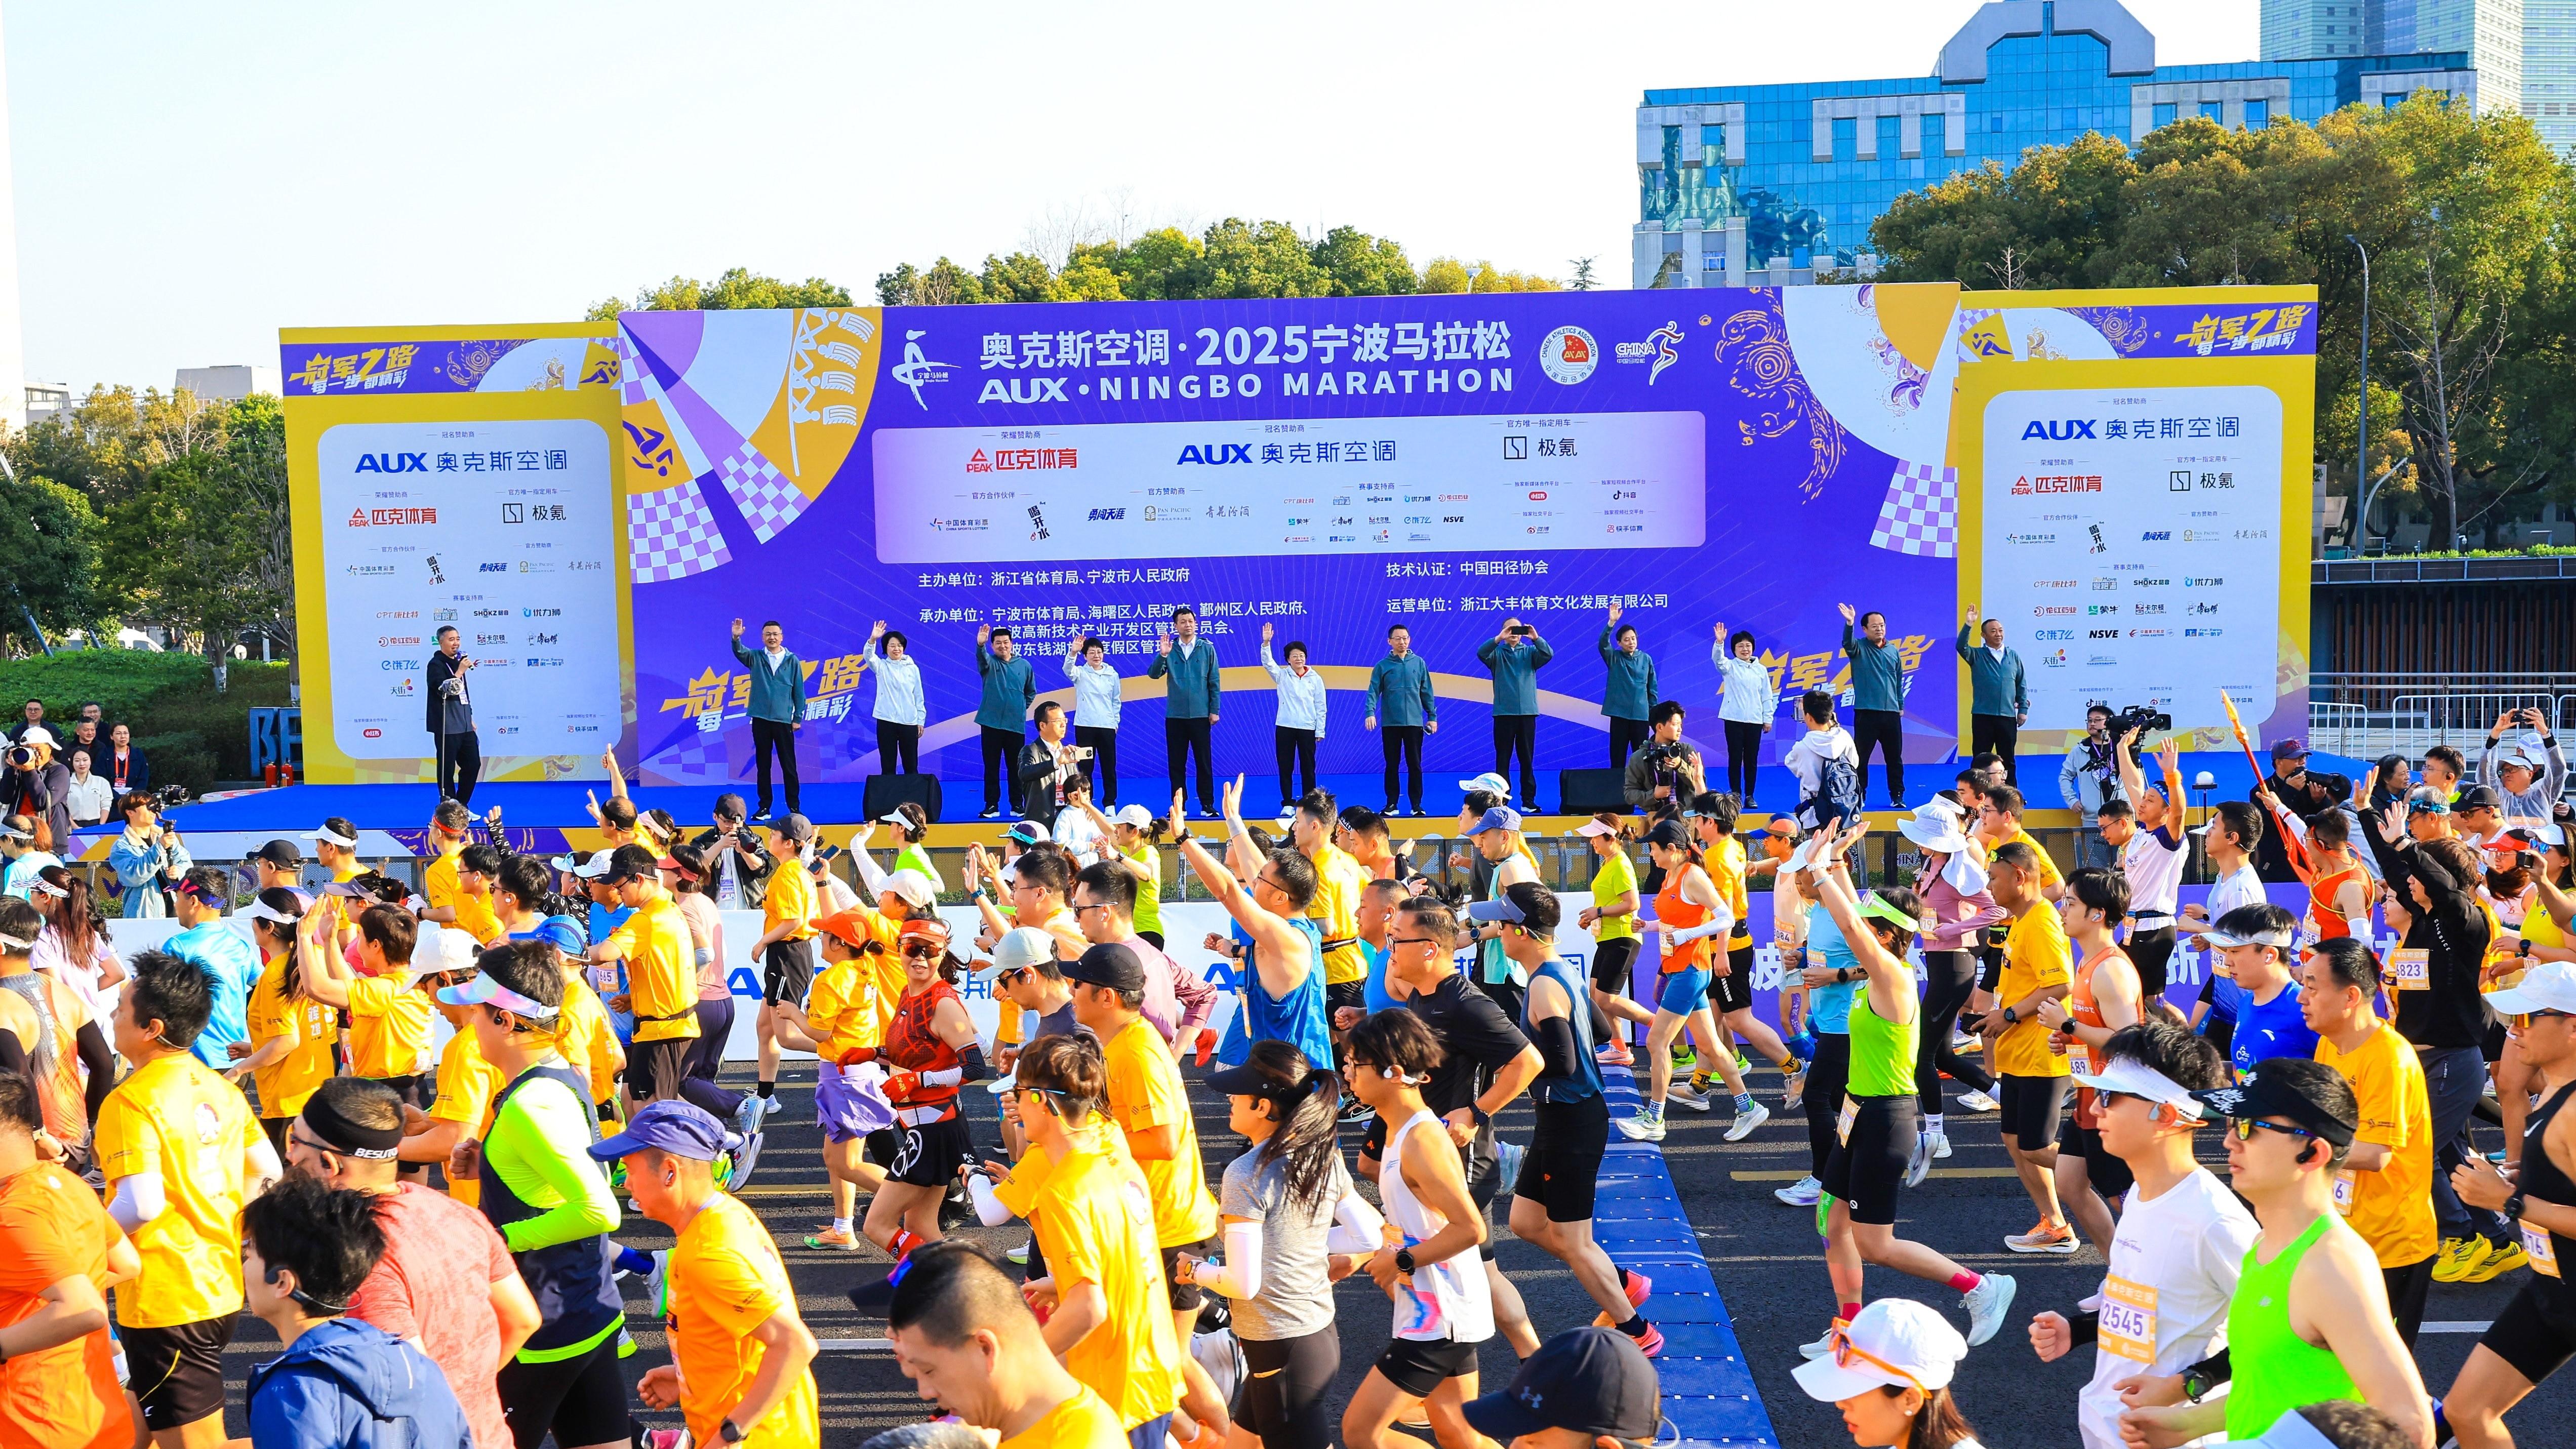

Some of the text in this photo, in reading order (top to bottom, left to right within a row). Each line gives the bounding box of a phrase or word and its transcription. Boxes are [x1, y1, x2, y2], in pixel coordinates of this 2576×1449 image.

[1542, 337, 1553, 358] CHINESE
[1552, 328, 1577, 340] ATHLETICS
[1577, 330, 1597, 357] ASSOCIATION
[1616, 343, 1656, 355] CHINA
[1284, 369, 1513, 396] MARATHON
[1264, 424, 1305, 434] 冠名赞助商
[1507, 419, 1571, 427] 官方唯一指定用车
[2022, 417, 2239, 440] AUX 奥克斯空调
[1001, 431, 1041, 439] 荣耀赞助商
[1177, 440, 1396, 465] AUX 奥克斯空调
[1539, 438, 1577, 457] 极氪
[355, 450, 567, 472] AUX 奥克斯空调
[967, 448, 1077, 473] PEAK 匹克体育
[2036, 476, 2102, 493] 匹克体育
[2200, 472, 2235, 489] 极氪
[372, 508, 436, 525] 匹克体育
[533, 505, 566, 520] 极氪
[1088, 508, 1126, 521] 勇闯天涯
[1028, 505, 1050, 540] 喝开水
[2089, 525, 2106, 553] 喝开水
[2142, 532, 2171, 541] 勇闯天涯
[426, 556, 446, 584] 喝开水
[479, 563, 507, 572] 勇闯天涯
[2100, 606, 2118, 614] 蒙牛
[2089, 630, 2118, 638] NSVE
